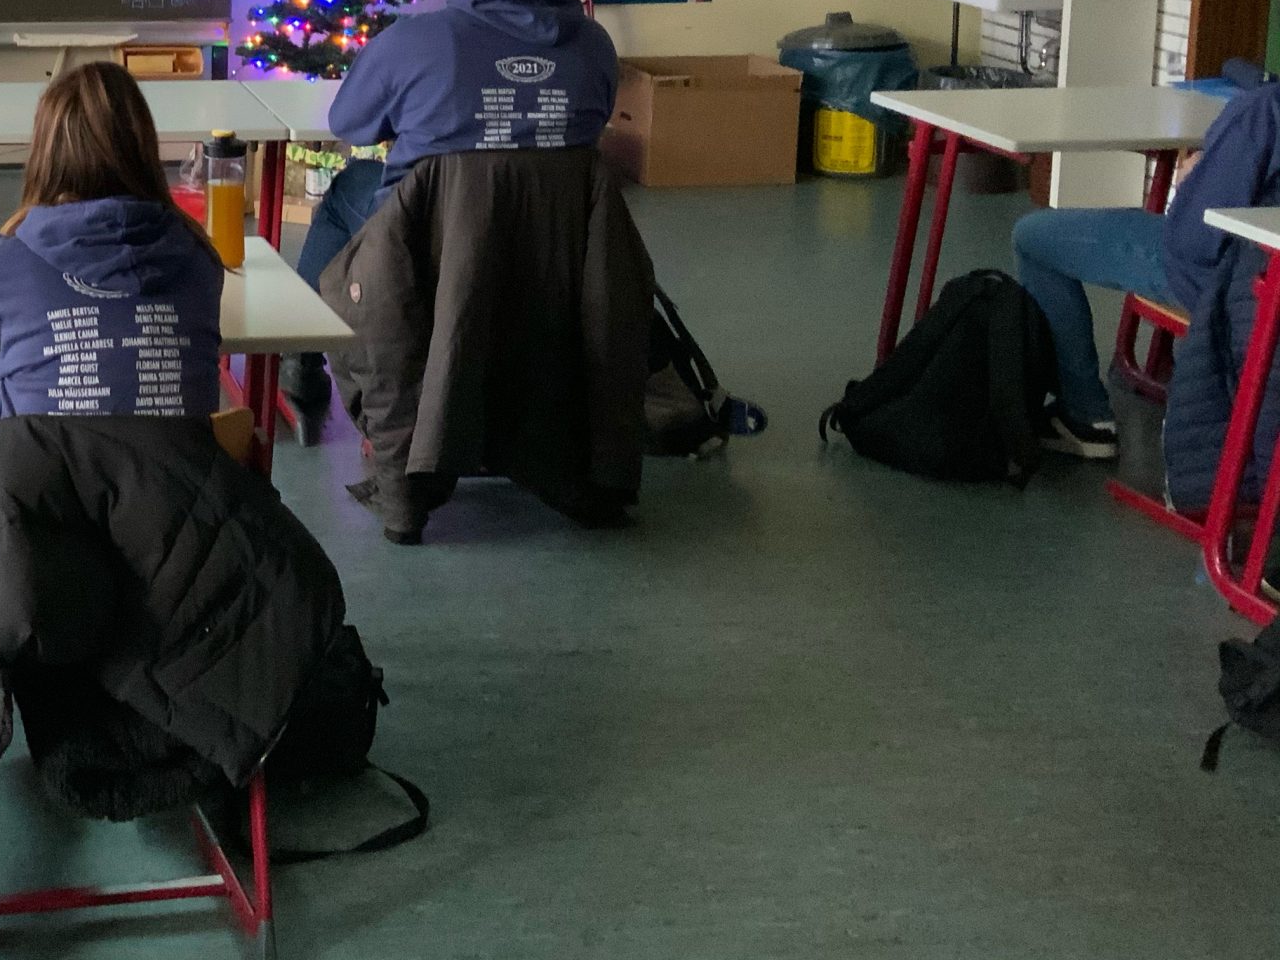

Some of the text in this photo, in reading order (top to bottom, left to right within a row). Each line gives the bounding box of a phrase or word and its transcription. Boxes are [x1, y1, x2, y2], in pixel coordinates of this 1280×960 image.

[512, 62, 538, 74] 2021
[46, 307, 71, 321] SAMUEL
[60, 352, 80, 364] LUKAS
[58, 376, 81, 386] MARCEL
